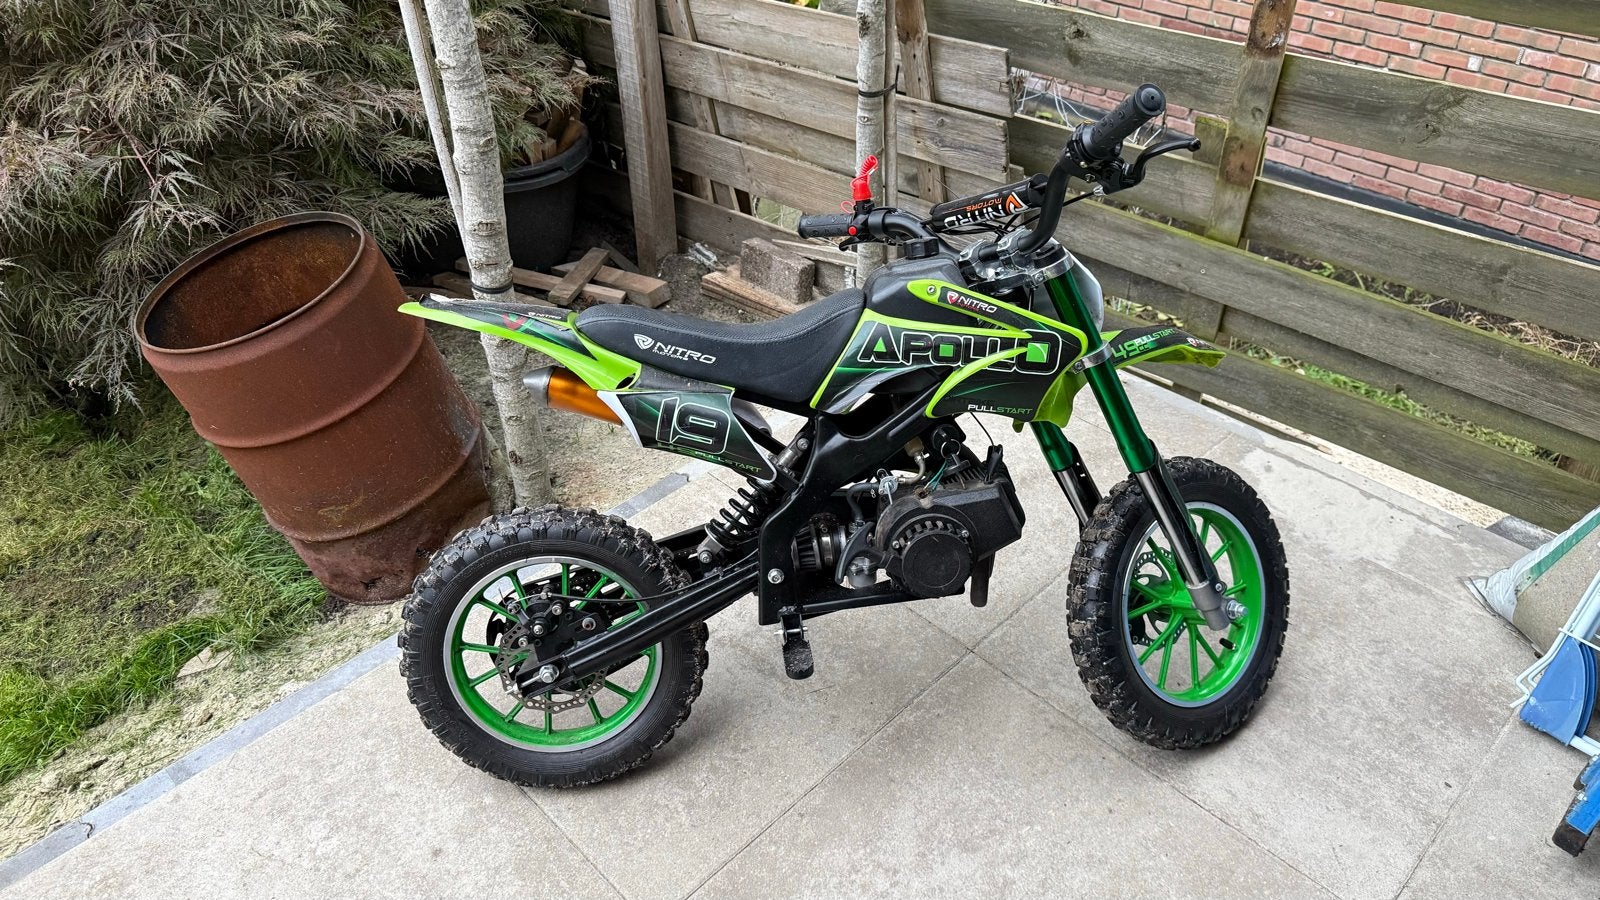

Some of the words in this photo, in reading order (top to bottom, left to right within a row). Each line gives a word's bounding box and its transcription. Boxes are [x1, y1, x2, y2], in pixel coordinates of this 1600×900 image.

[966, 197, 1002, 212] MOTORS
[943, 204, 1006, 229] NITRO
[958, 295, 998, 313] NITRO
[652, 349, 689, 361] MOTORS
[654, 341, 717, 364] NITRO
[857, 321, 1062, 376] APOLLO
[967, 403, 1033, 414] PULLSTART
[655, 396, 731, 455] 19
